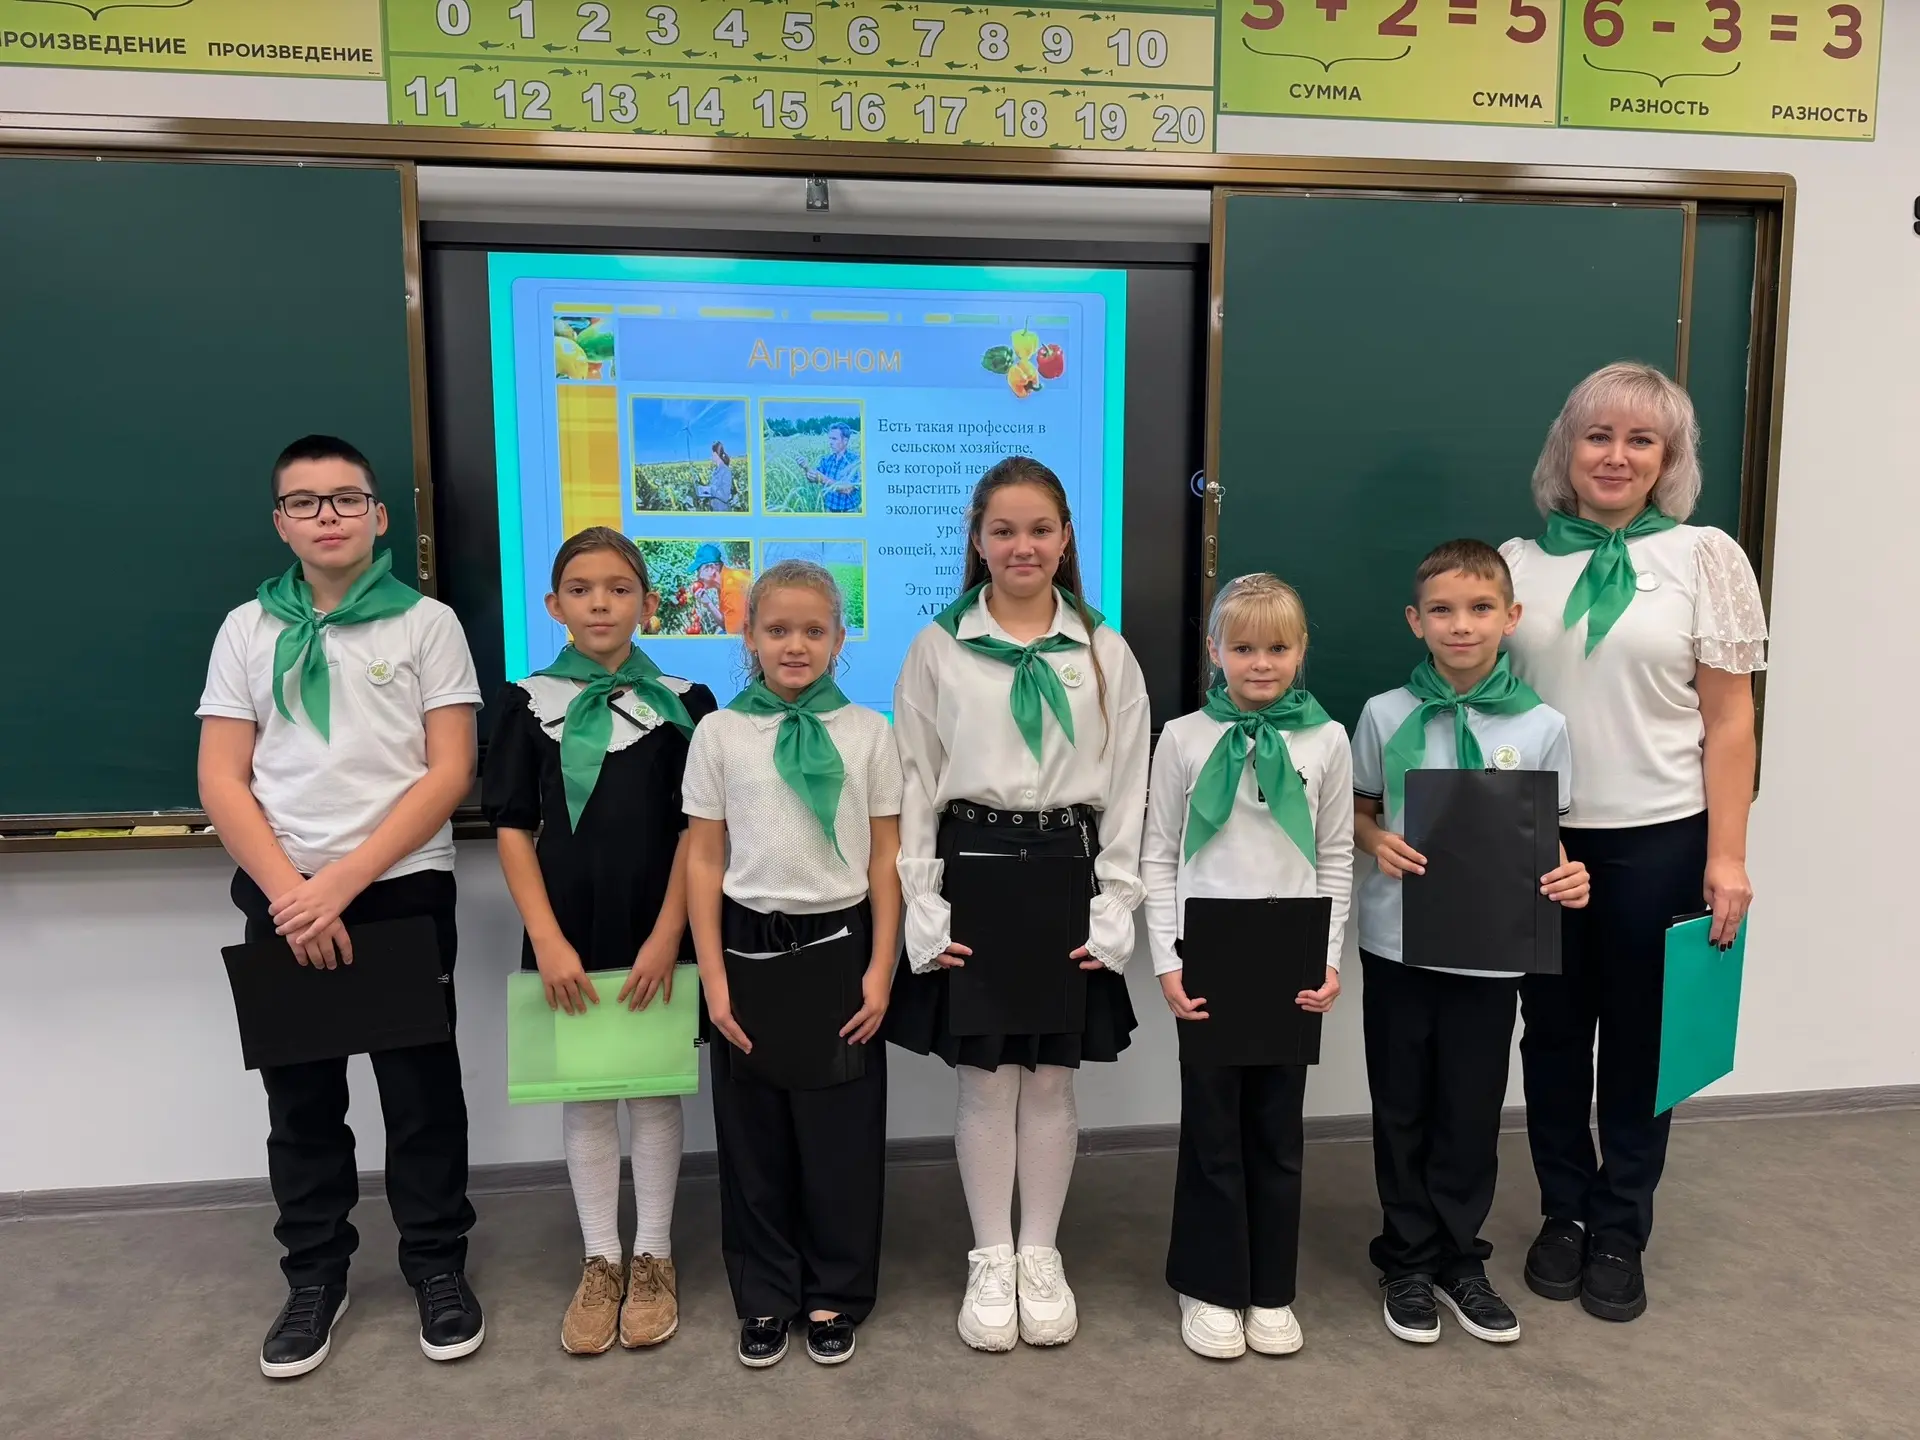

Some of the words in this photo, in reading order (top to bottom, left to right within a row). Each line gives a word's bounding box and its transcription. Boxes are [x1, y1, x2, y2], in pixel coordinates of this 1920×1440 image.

[1378, 0, 1418, 36] 2
[1505, 0, 1547, 44] 5
[1583, 0, 1625, 47] 6
[1701, 0, 1742, 53] 3
[1822, 4, 1863, 60] 3
[0, 31, 187, 55] РОИЗВЕДЕНИЕ
[436, 0, 471, 36] 0
[508, 0, 535, 39] 1
[576, 2, 611, 42] 2
[646, 5, 680, 45] 3
[713, 8, 748, 48] 4
[781, 12, 815, 51] 5
[847, 16, 880, 55] 6
[912, 18, 945, 57] 7
[978, 22, 1010, 61] 8
[1042, 25, 1073, 64] 9
[1107, 28, 1168, 68] 10
[208, 42, 373, 63] ПРОИЗВЕДЕНИЕ
[1289, 83, 1362, 101] СУММА
[1472, 91, 1543, 109] СУММА
[405, 76, 458, 117] 11
[494, 79, 552, 120] 12
[582, 82, 638, 124] 13
[668, 86, 724, 126] 14
[753, 89, 808, 130] 15
[832, 92, 886, 132] 16
[914, 95, 968, 134] 17
[995, 98, 1048, 138] 18
[1075, 102, 1127, 141] 19
[1152, 105, 1205, 144] 20
[1610, 97, 1710, 115] РАЗНОСТЬ
[1771, 105, 1868, 122] РАЗНОСТЬ
[748, 338, 901, 378] Агроном
[878, 418, 912, 432] Есть
[915, 422, 954, 432] такая
[958, 420, 1034, 436] профессия
[1038, 424, 1046, 434] в
[891, 442, 956, 453] сельском
[960, 441, 1033, 454] хозяйстве,
[878, 461, 900, 474] без
[904, 462, 961, 476] которой
[965, 465, 988, 474] нев
[888, 484, 960, 495] вырастить
[886, 504, 965, 515] экологичес
[936, 525, 963, 538] уро
[878, 544, 936, 556] овощей,
[940, 546, 964, 556] хле
[935, 566, 962, 576] пло
[905, 583, 932, 596] Это
[936, 586, 961, 598] про
[916, 603, 950, 616] АГР
